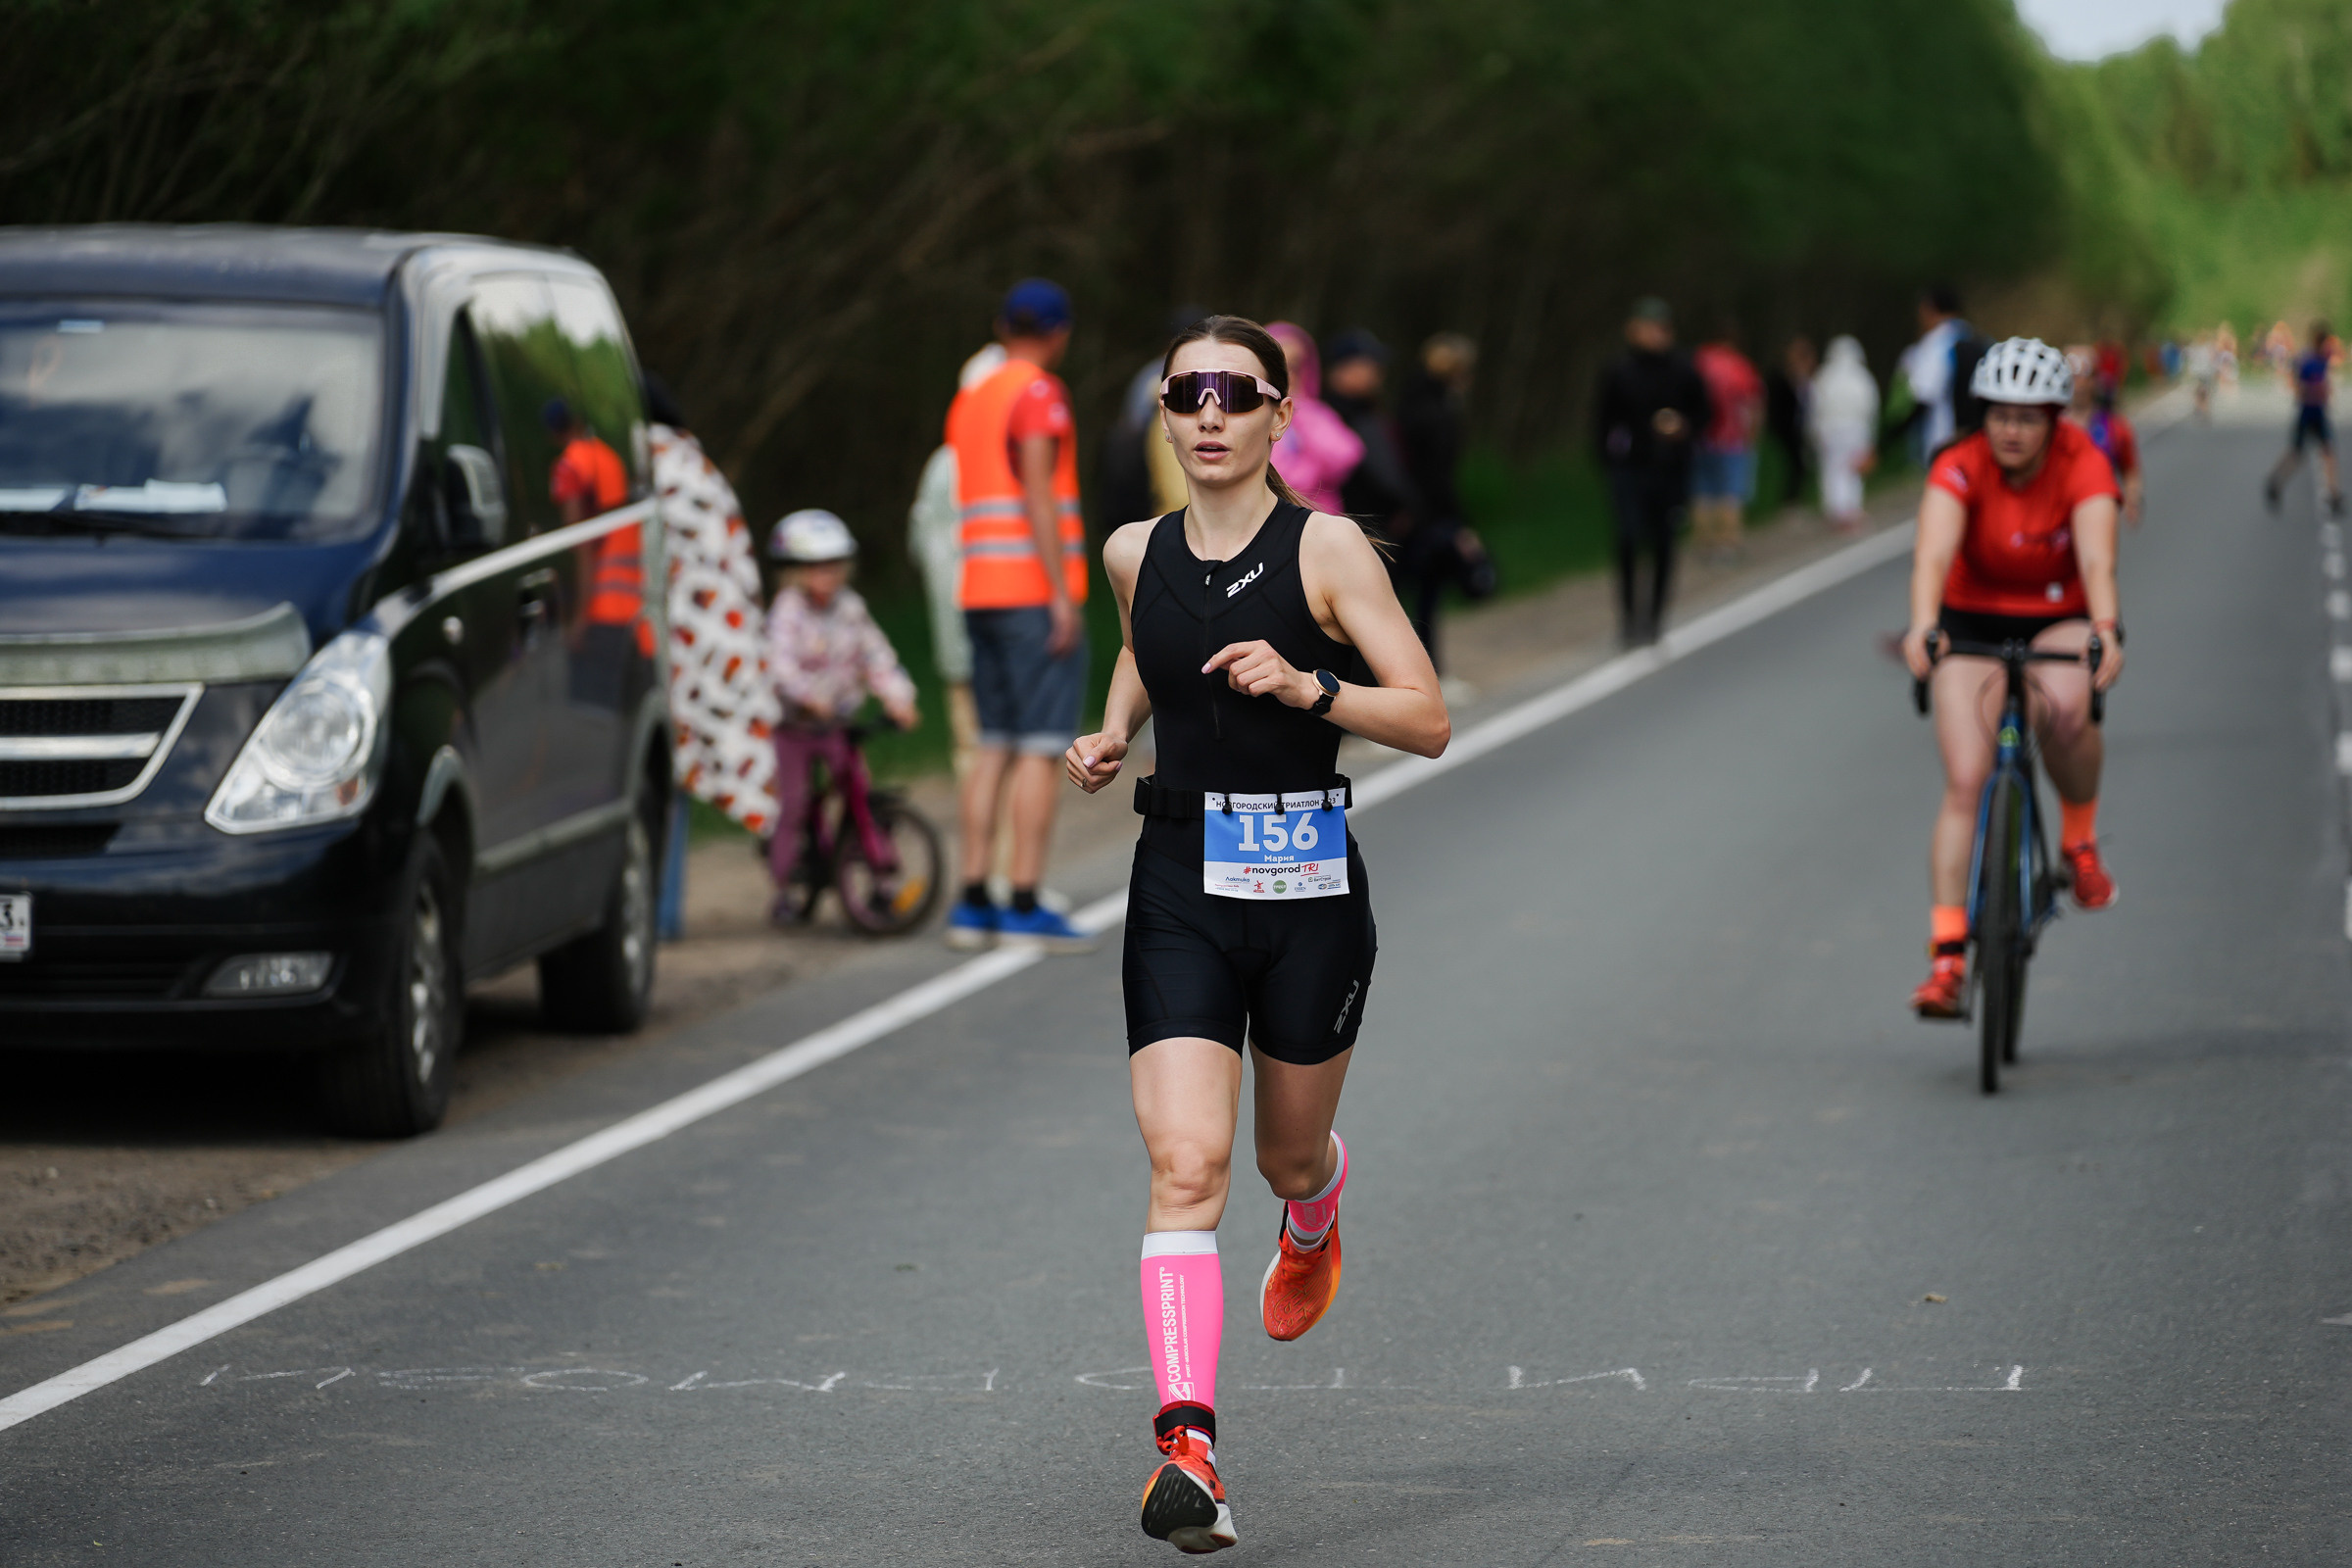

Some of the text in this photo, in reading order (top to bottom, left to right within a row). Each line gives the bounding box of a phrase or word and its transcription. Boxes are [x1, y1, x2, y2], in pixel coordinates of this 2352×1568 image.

[1227, 563, 1263, 598] 2XU
[1216, 801, 1279, 811] НОГОРОДСКИ
[1321, 797, 1336, 806] 223
[1238, 812, 1319, 852] 156
[1264, 854, 1295, 863] Мария
[1334, 980, 1359, 1034] 2XU
